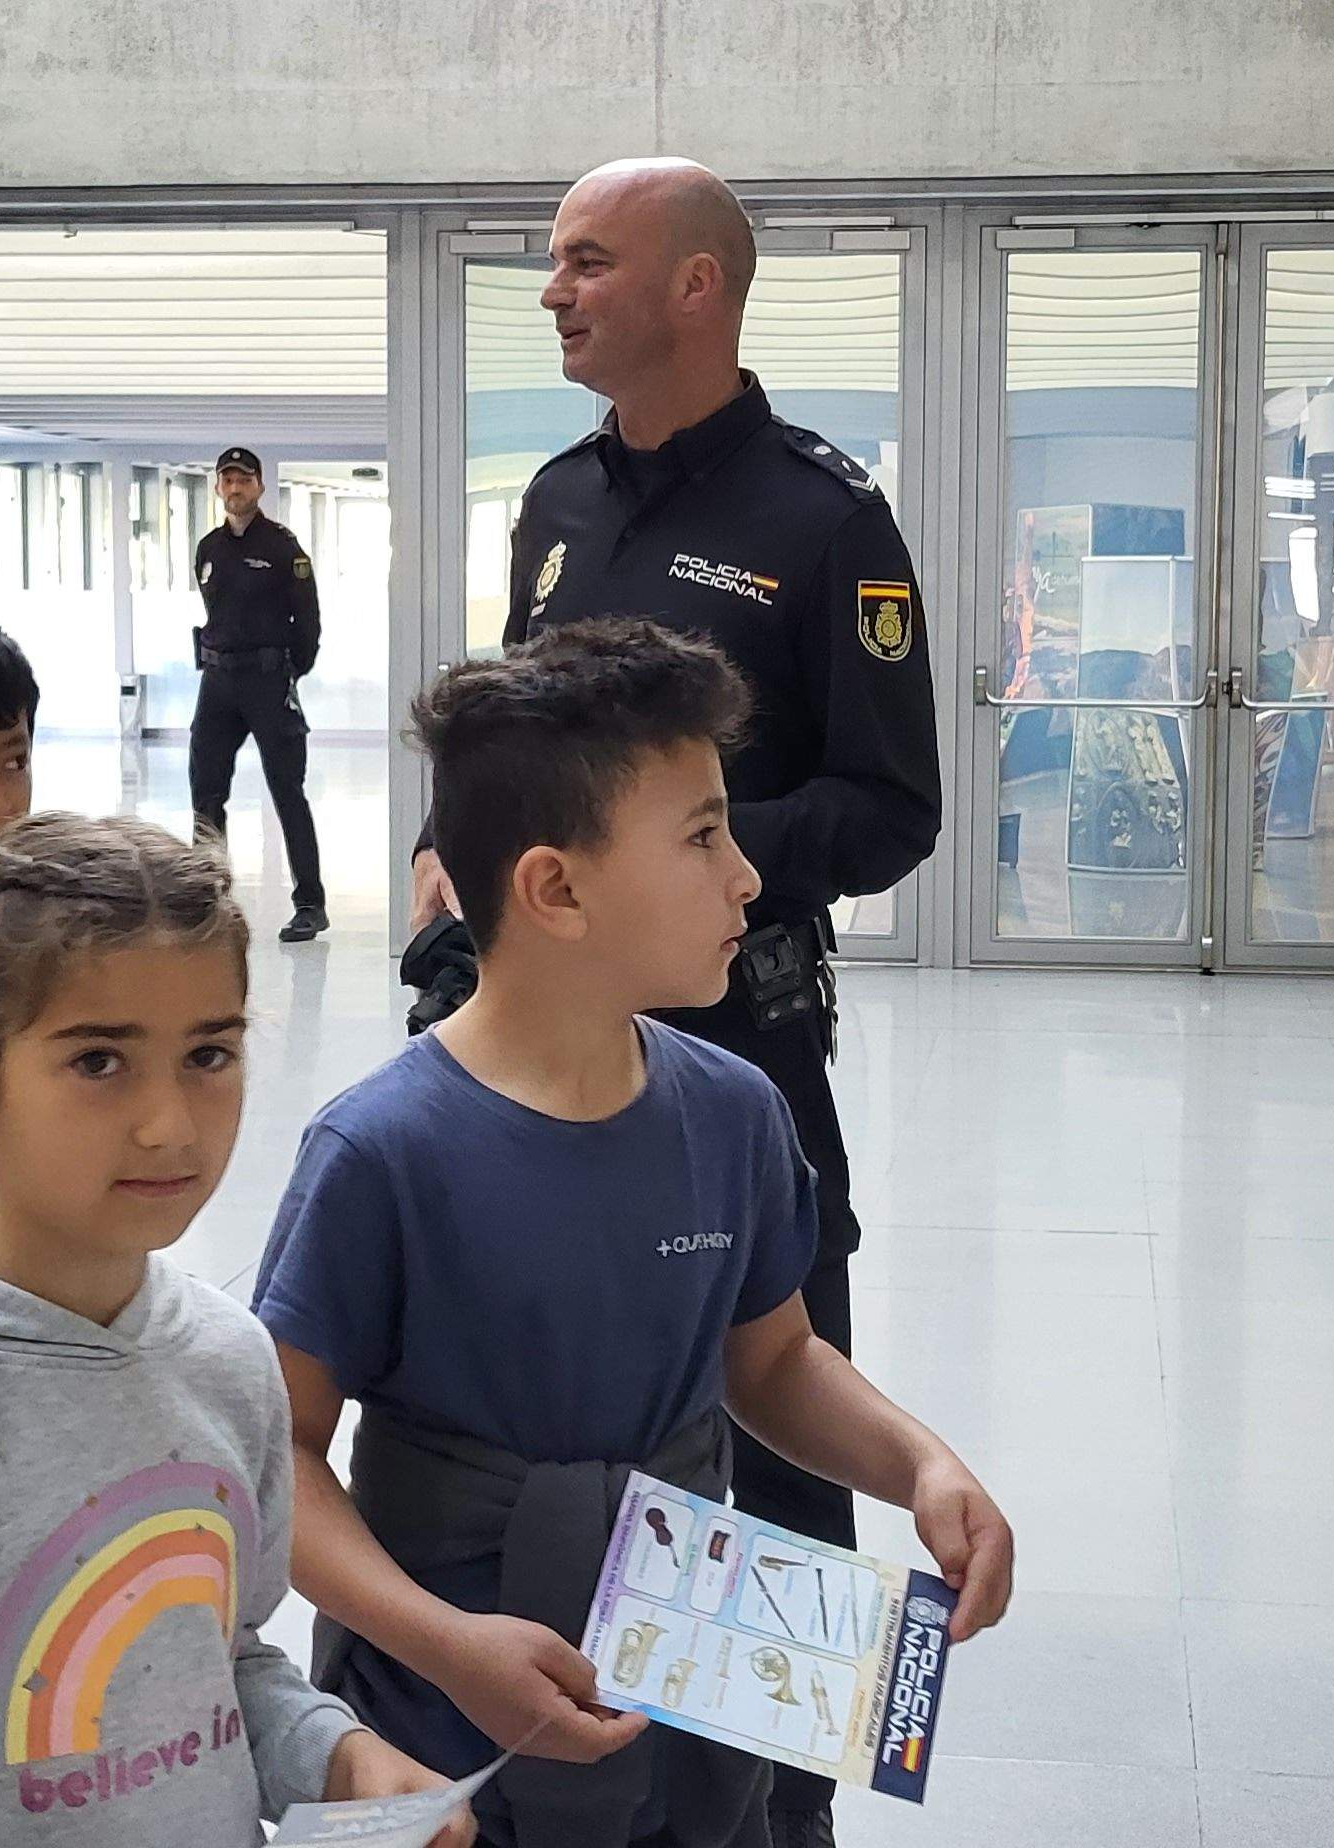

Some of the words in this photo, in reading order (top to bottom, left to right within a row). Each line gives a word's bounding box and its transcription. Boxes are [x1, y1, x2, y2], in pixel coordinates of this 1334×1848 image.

[668, 565, 773, 605] NACIONAL
[673, 553, 752, 584] POLICIA
[882, 1621, 924, 1765] NACIONAL
[906, 1627, 943, 1738] POLICIA
[18, 1730, 202, 1814] believe
[210, 1703, 241, 1750] in
